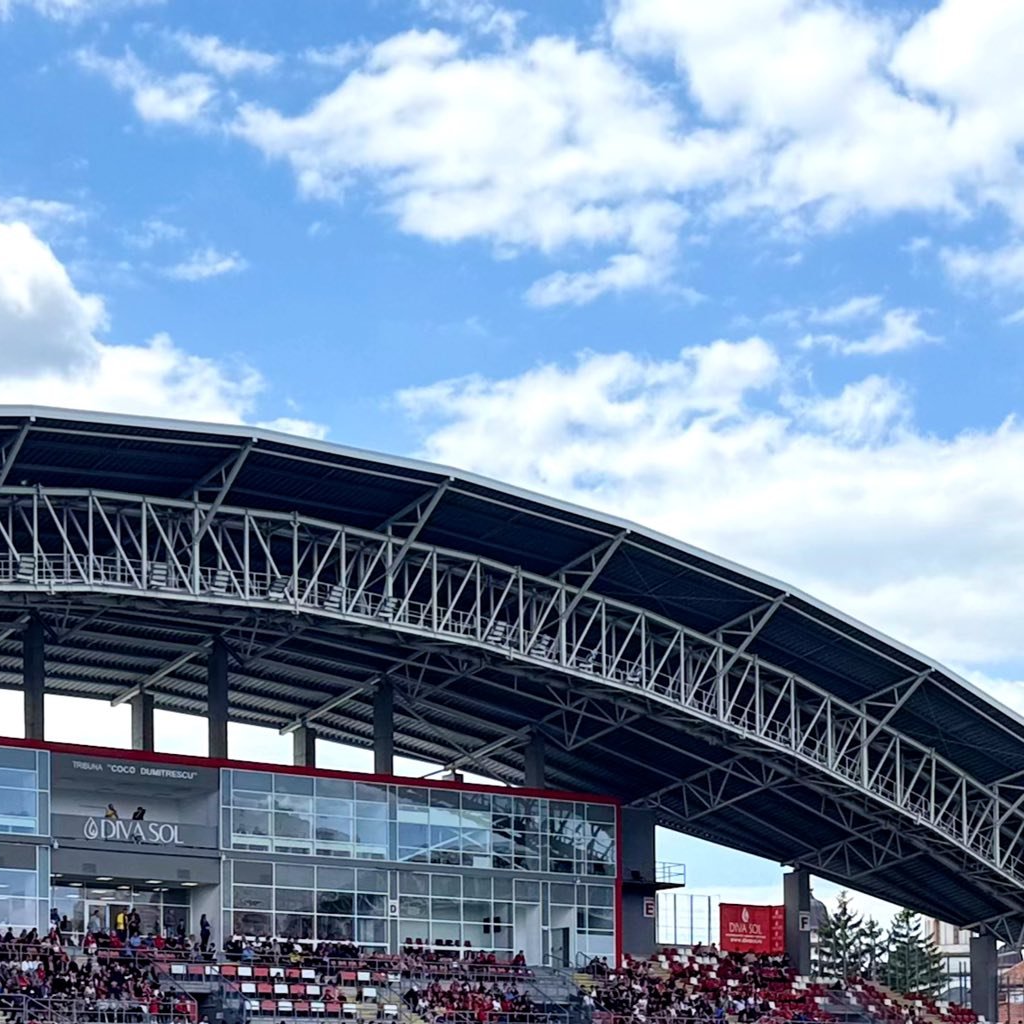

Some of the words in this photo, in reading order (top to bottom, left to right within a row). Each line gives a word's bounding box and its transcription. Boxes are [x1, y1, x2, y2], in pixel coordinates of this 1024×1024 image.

[101, 819, 146, 841] DIVA
[148, 822, 184, 844] SOL
[801, 916, 809, 929] F
